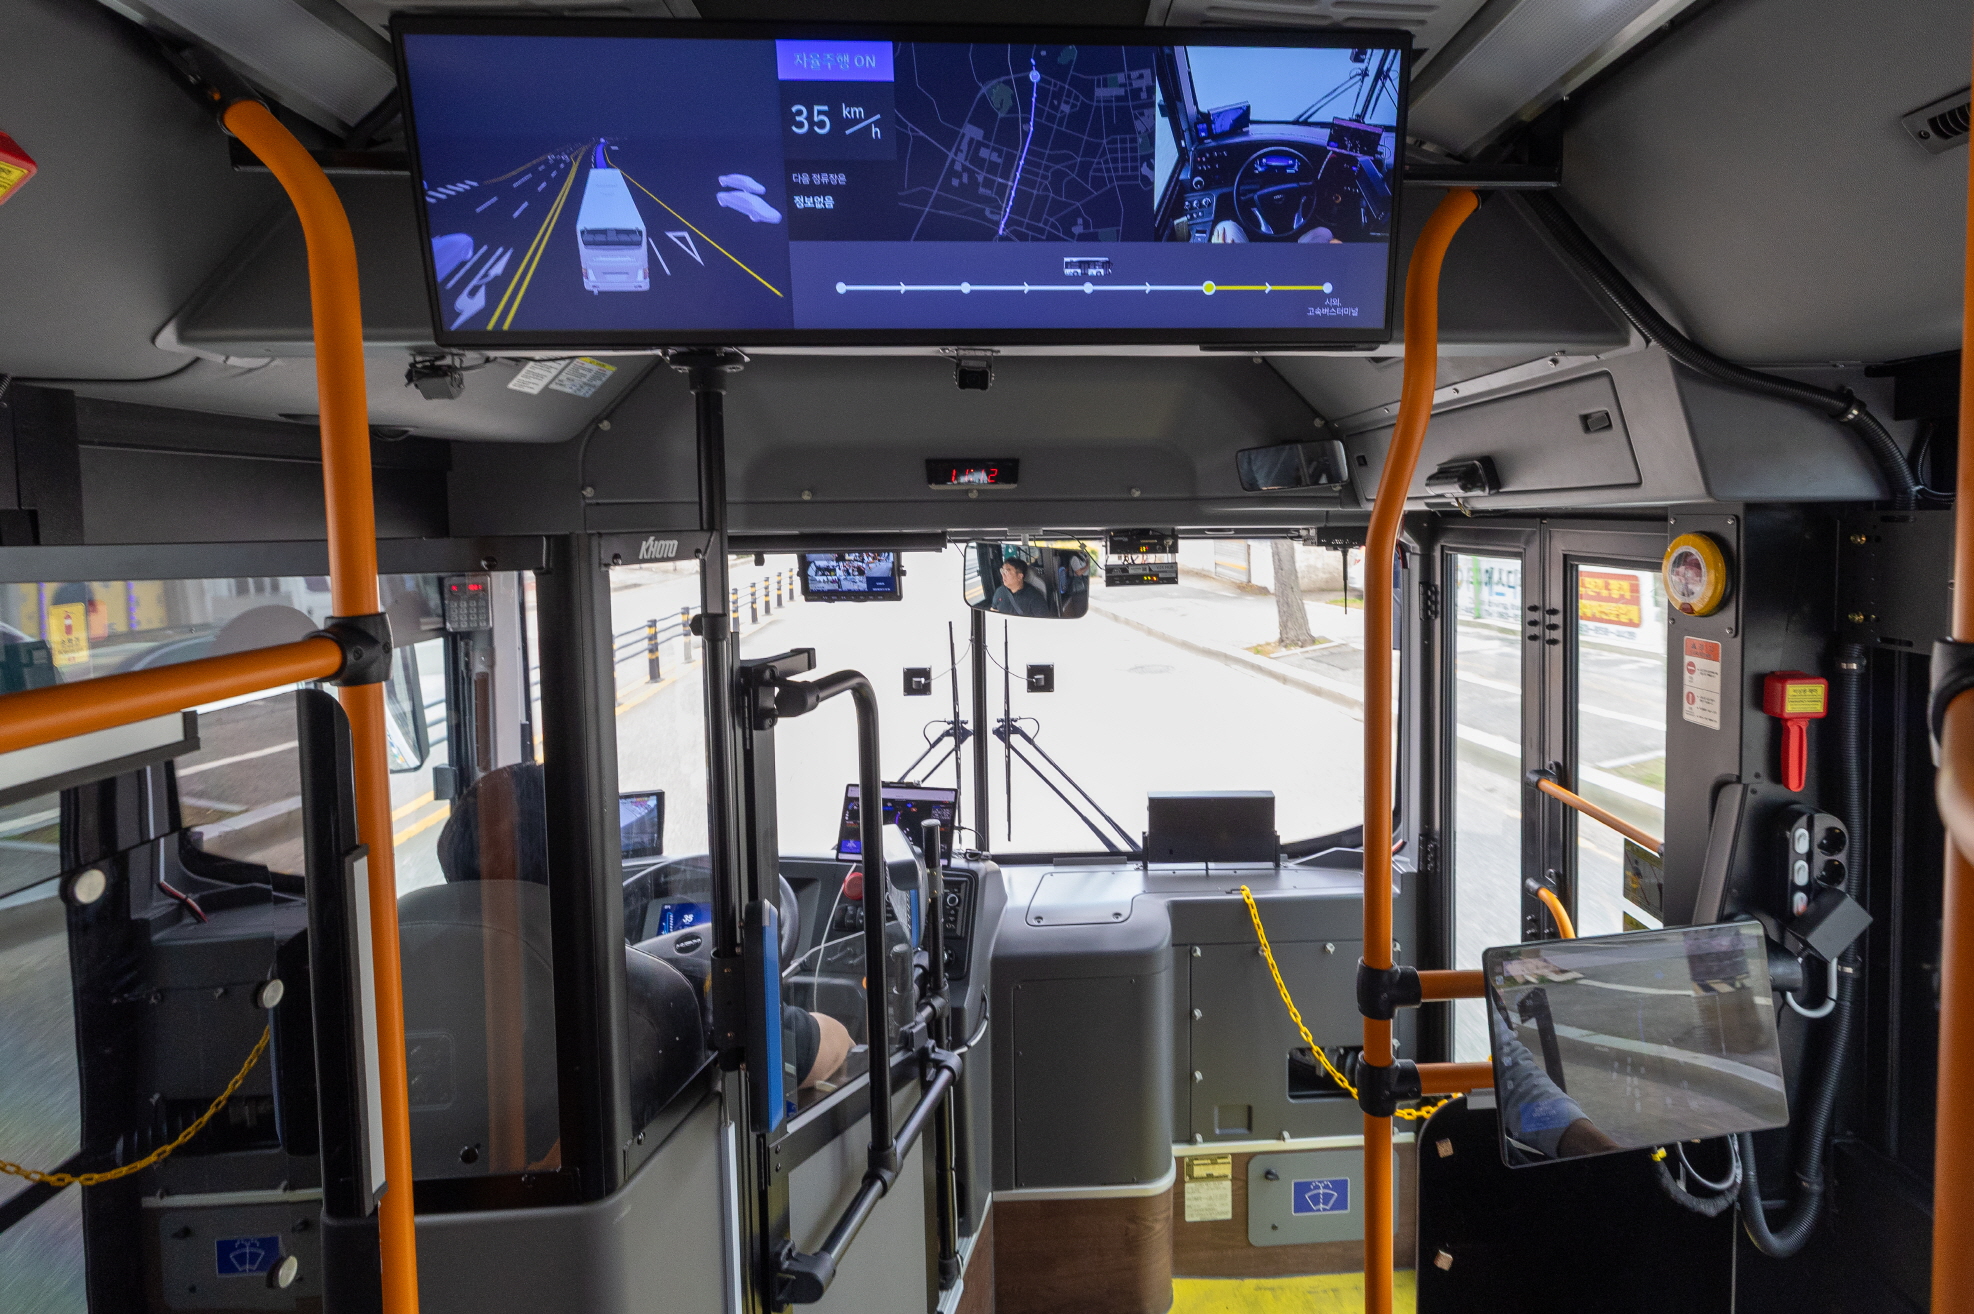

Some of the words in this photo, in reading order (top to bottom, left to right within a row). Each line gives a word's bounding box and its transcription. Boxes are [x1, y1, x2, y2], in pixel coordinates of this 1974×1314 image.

[793, 52, 850, 71] 자율주행
[854, 54, 877, 69] ON
[790, 103, 831, 135] 35
[792, 172, 809, 185] 다음
[811, 172, 847, 186] 정류장은
[793, 195, 835, 210] 정보없음
[1306, 307, 1359, 317] 고속버스터미널
